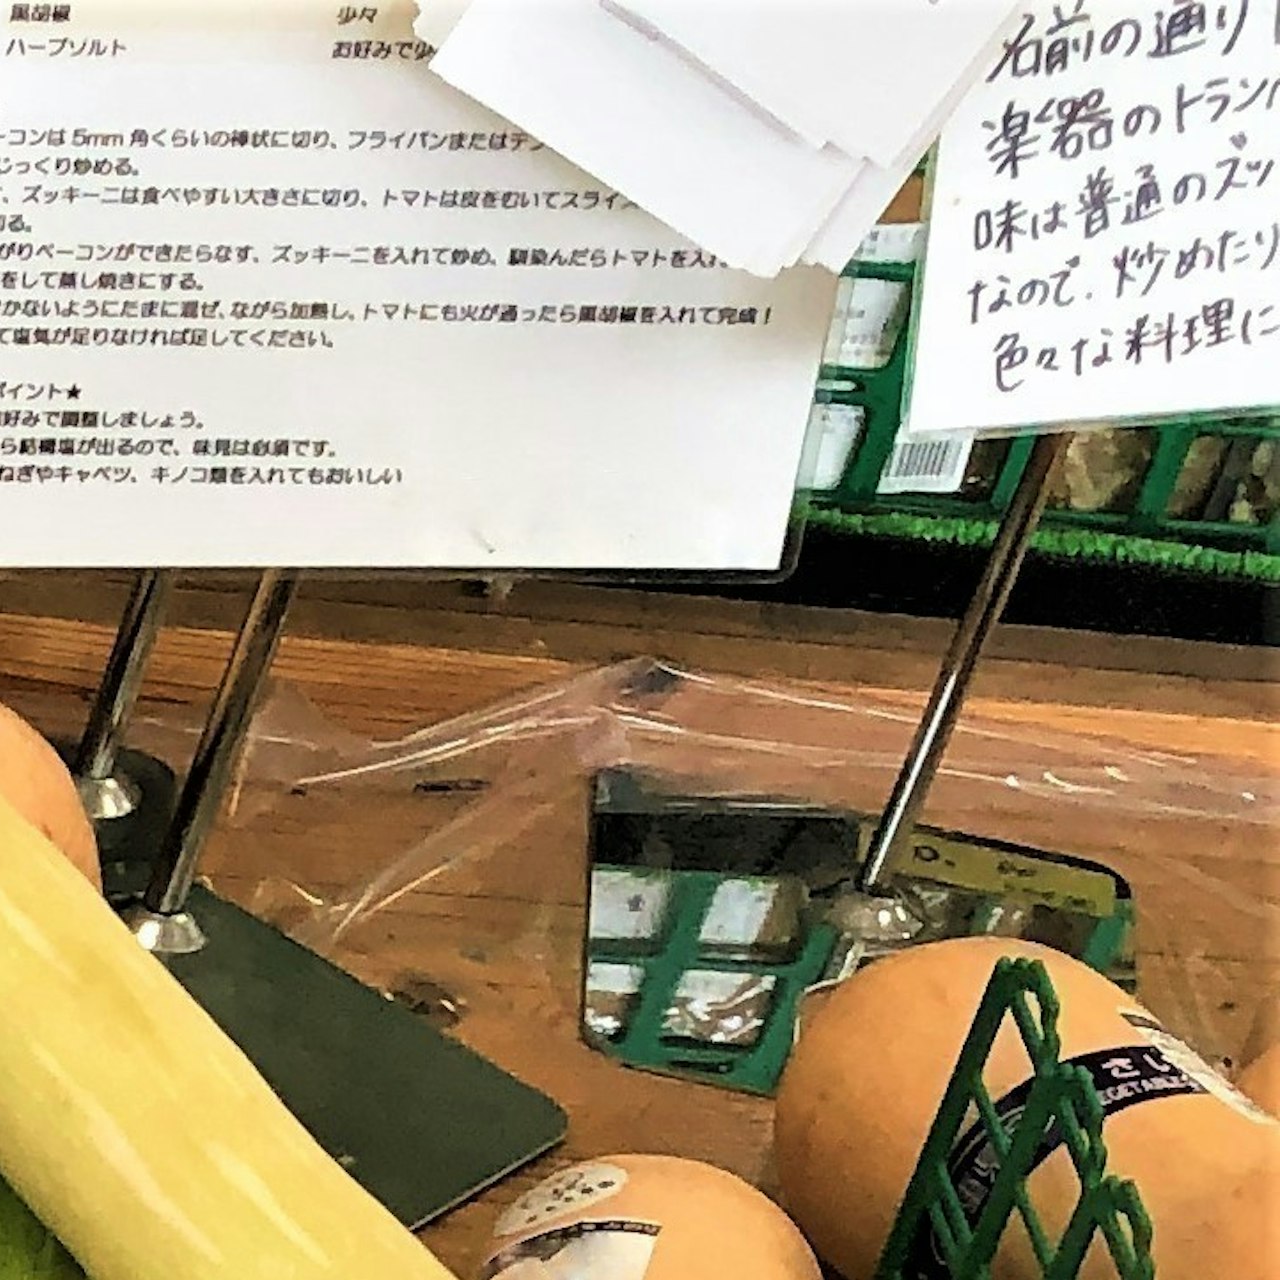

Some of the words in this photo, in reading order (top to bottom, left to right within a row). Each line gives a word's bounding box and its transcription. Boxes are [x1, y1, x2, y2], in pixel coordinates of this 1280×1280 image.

[338, 7, 378, 25] 少々
[6, 38, 127, 57] ハーブソルト
